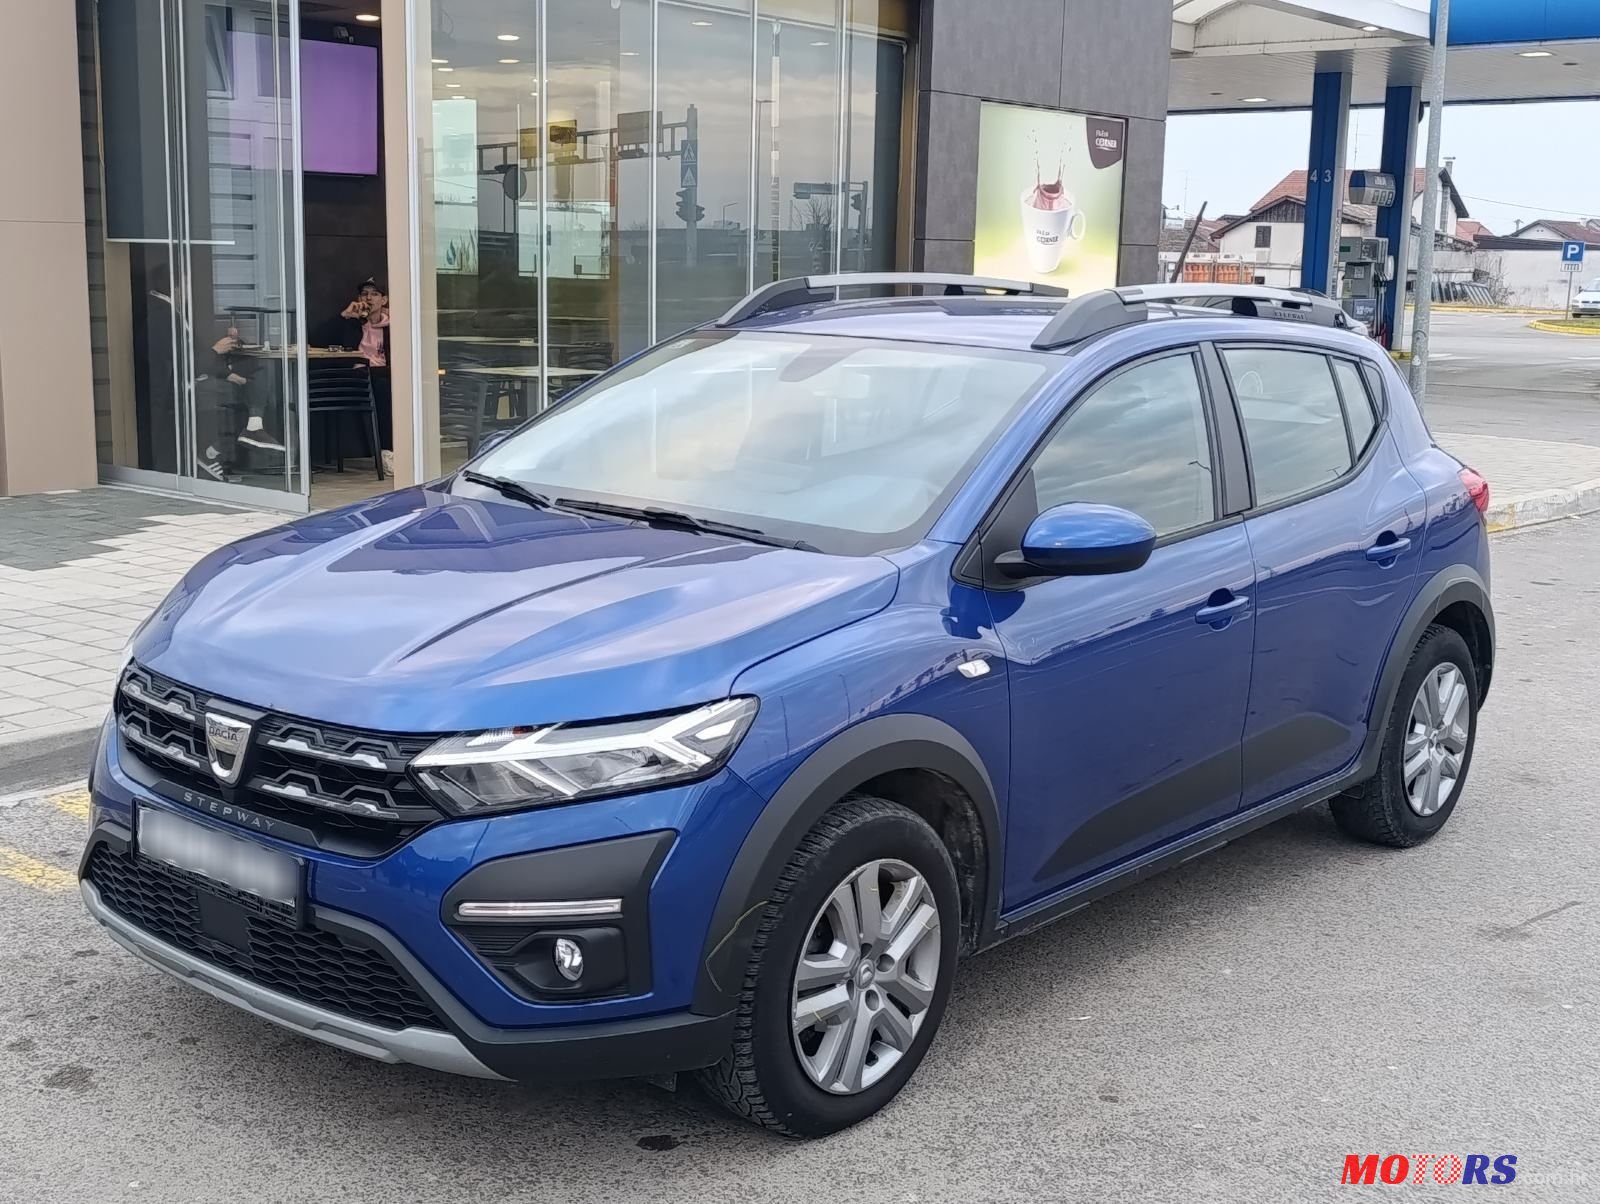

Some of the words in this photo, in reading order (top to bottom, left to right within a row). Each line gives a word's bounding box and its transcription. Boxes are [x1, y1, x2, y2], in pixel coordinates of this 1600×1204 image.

[1309, 168, 1318, 183] 4
[1324, 168, 1332, 183] 3
[1567, 244, 1580, 259] P
[208, 726, 238, 742] DACIA
[183, 791, 275, 831] STEPWAY
